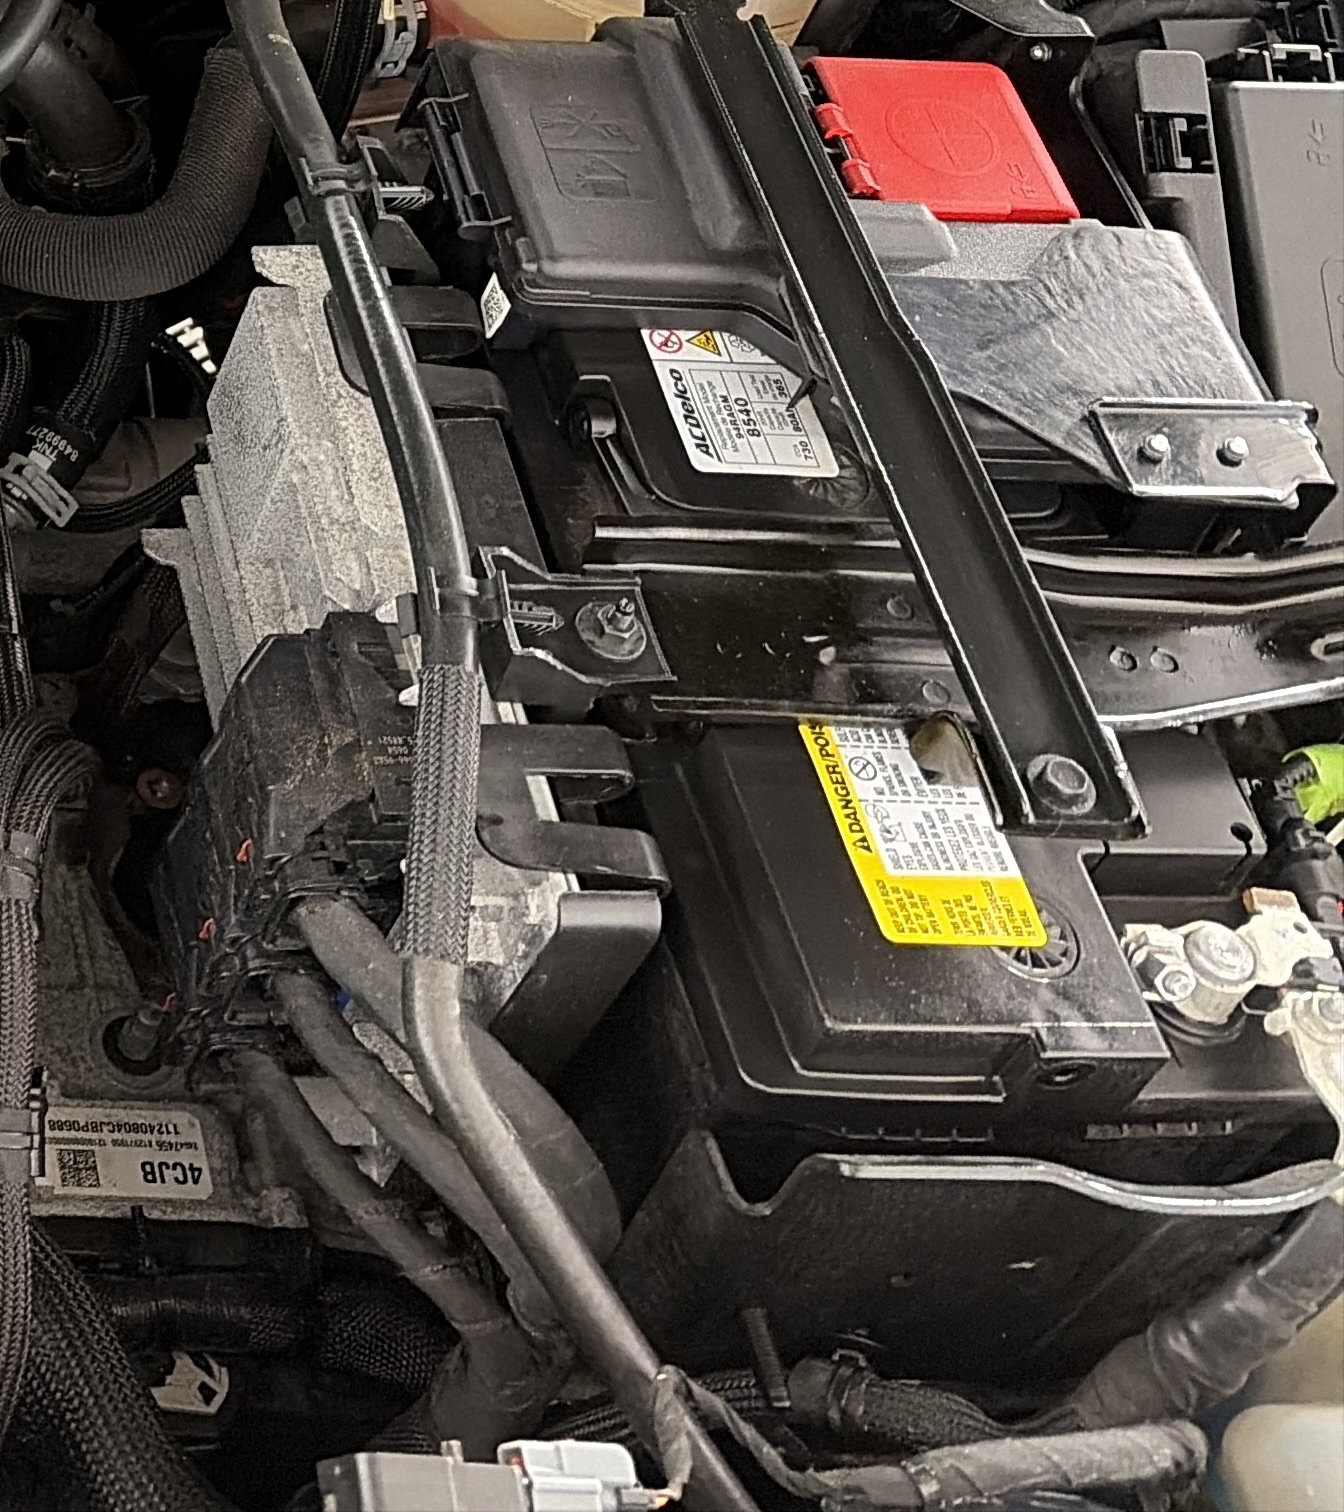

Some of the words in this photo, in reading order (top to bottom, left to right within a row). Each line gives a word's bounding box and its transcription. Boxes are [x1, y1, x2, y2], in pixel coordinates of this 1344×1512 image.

[771, 378, 789, 398] 365
[668, 368, 714, 458] ACDelco
[731, 396, 762, 437] 8540
[31, 439, 58, 462] TNK
[796, 439, 815, 461] 730
[141, 1160, 202, 1186] 4CJB
